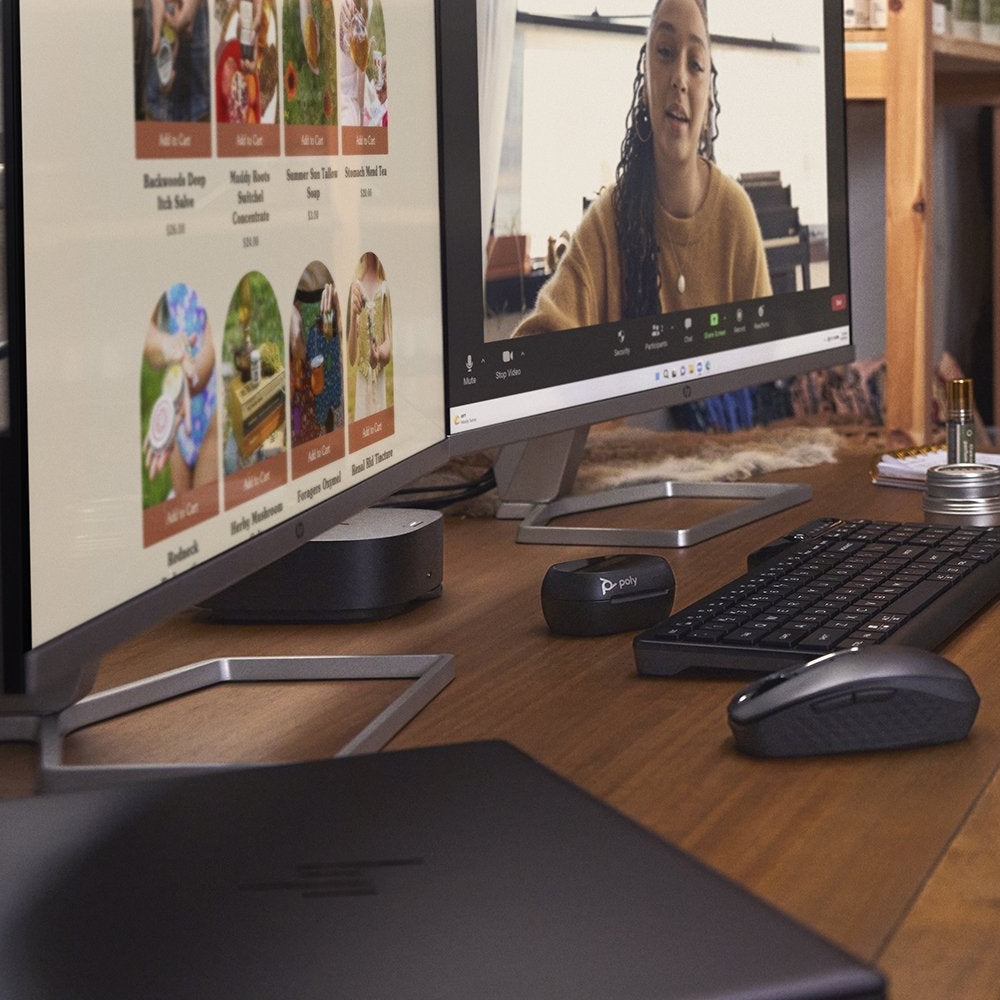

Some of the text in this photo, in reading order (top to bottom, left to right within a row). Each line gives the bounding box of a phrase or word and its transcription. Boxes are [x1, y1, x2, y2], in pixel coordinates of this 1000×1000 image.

[286, 166, 338, 181] Summer Sun Tallow
[344, 165, 387, 178] Stomach Mend Tea
[237, 189, 264, 204] Switchel
[306, 186, 321, 200] Soap
[232, 210, 270, 225] Concentrate
[614, 347, 631, 357] Security
[463, 377, 477, 385] Mute
[495, 368, 521, 380] Stop Video
[374, 449, 393, 465] Tincture
[297, 470, 341, 503] Foragers Oxymel
[230, 516, 250, 536] Herby
[251, 502, 284, 525] Mushroom
[167, 540, 199, 567] Redneck
[619, 575, 638, 589] poly
